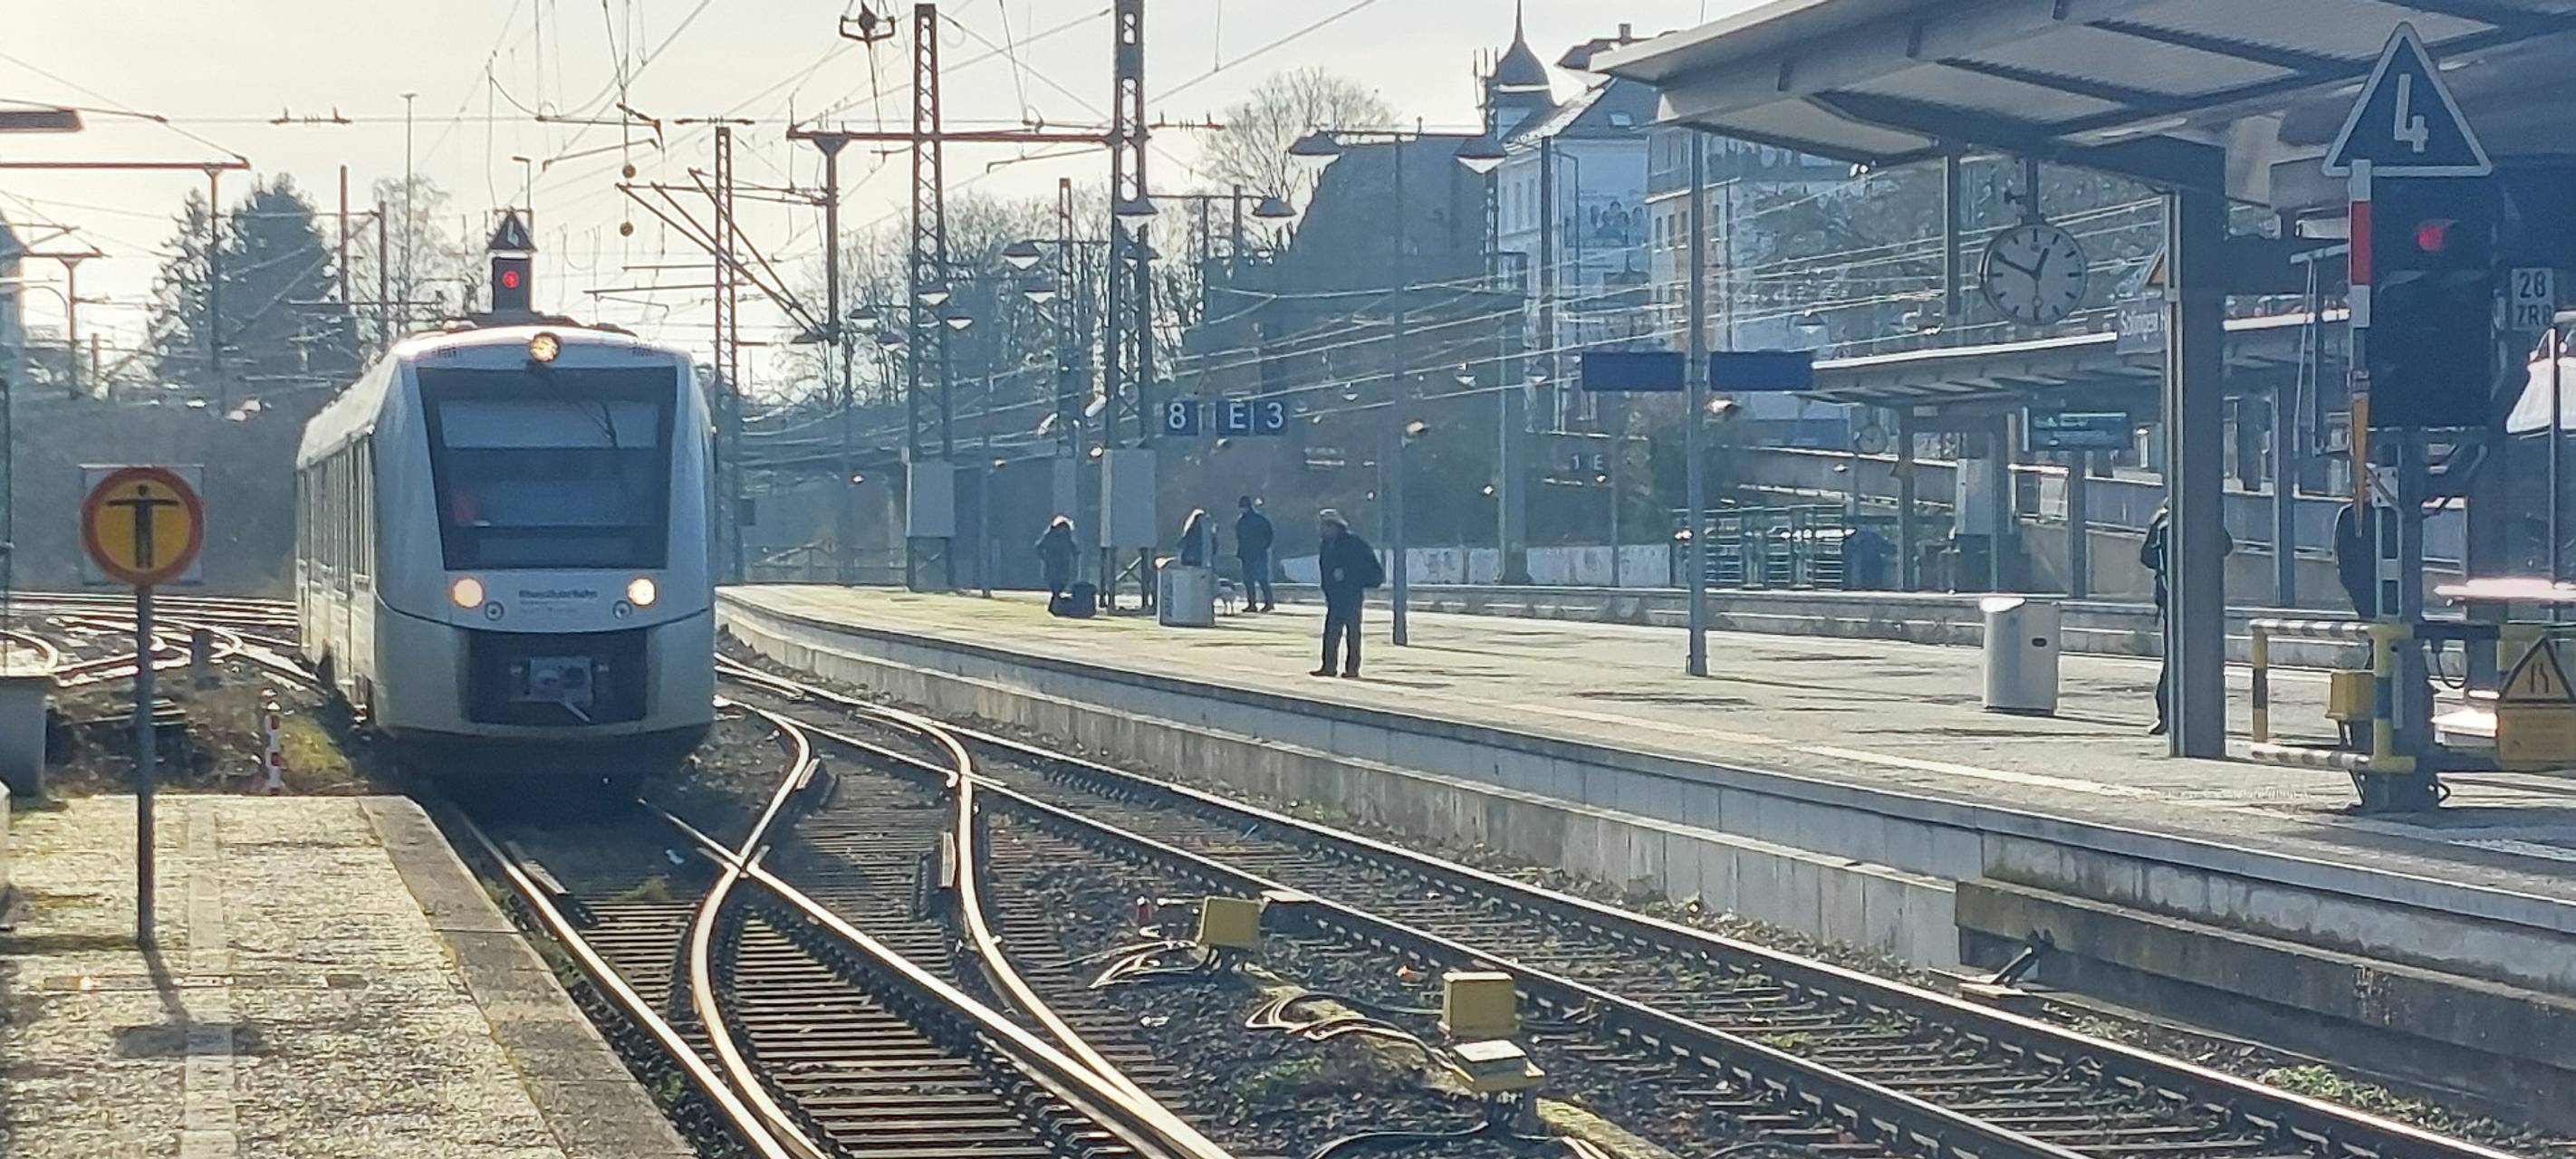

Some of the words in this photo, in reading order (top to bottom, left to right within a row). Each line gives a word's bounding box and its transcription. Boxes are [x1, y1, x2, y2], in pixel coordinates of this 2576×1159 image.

[2394, 73, 2429, 153] 4
[2519, 271, 2546, 298] 28
[1168, 402, 1187, 429] 8
[1229, 403, 1247, 429] E
[1266, 402, 1284, 428] 3
[1572, 455, 1580, 471] 1
[1593, 454, 1604, 471] E
